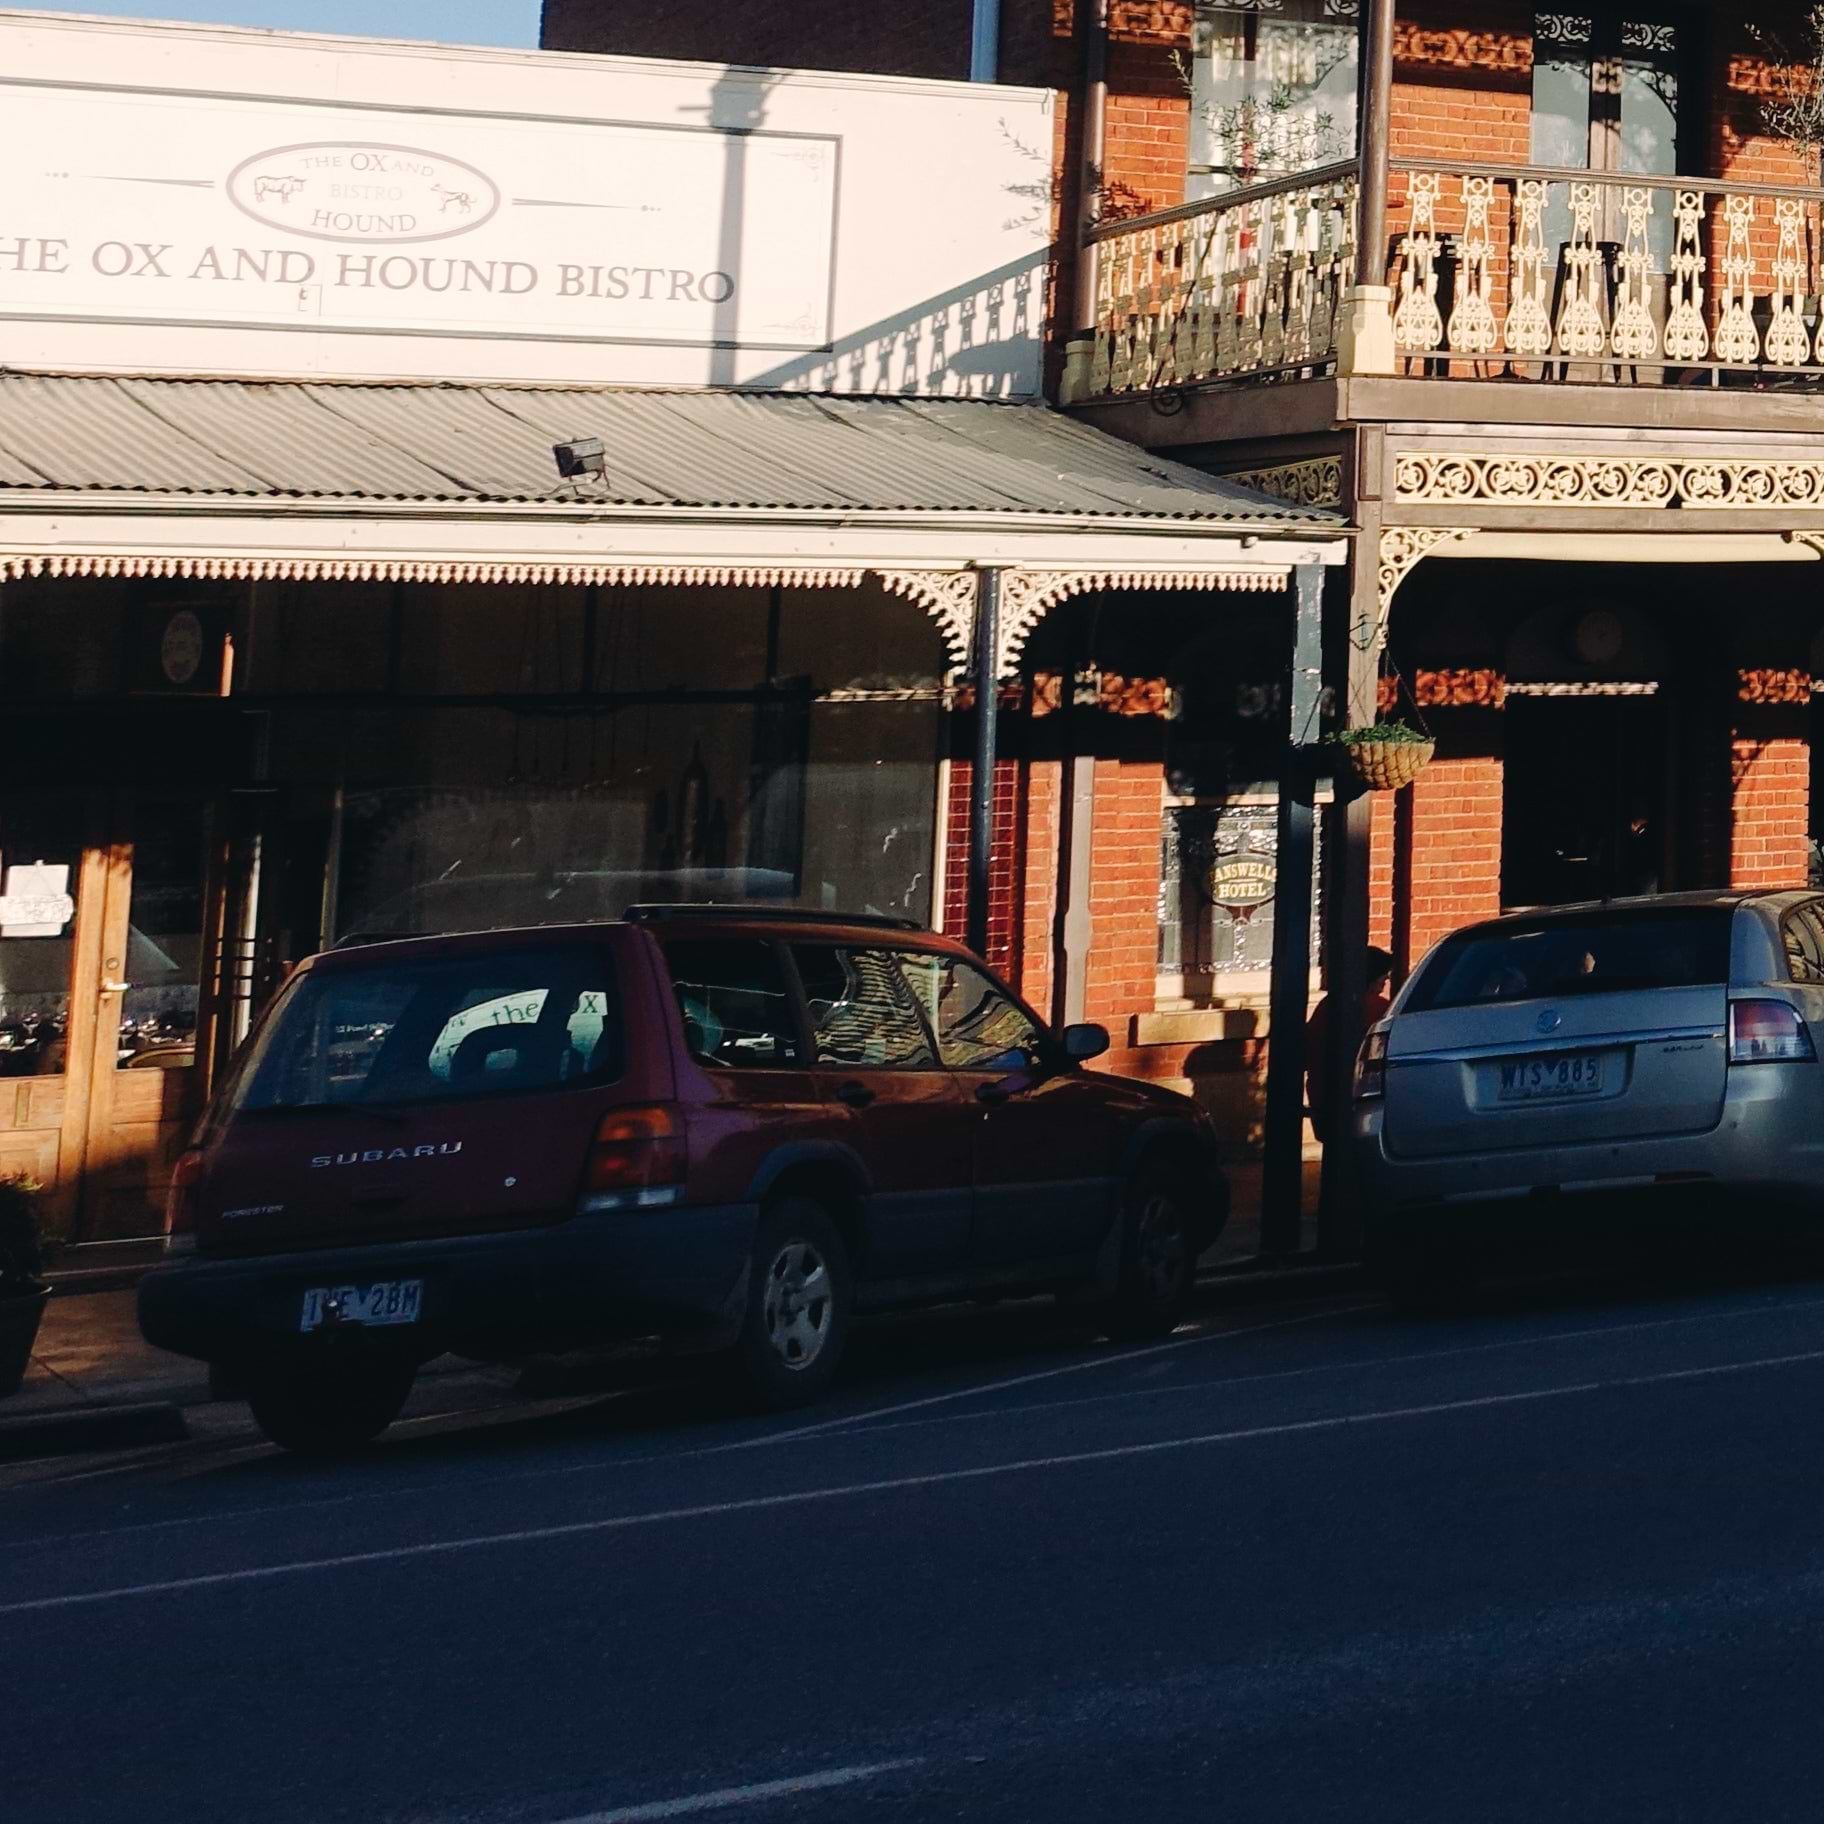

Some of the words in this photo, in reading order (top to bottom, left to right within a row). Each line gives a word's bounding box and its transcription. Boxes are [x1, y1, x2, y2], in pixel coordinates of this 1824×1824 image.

[299, 155, 343, 169] THE
[350, 152, 389, 172] OX
[391, 160, 435, 177] AND
[329, 183, 403, 201] BISTRO
[311, 209, 417, 233] HOUND
[0, 236, 70, 275] HE
[92, 240, 174, 278] OX
[190, 245, 316, 285] AND
[333, 253, 538, 295] HOUND
[556, 263, 735, 304] BISTRO
[1214, 862, 1277, 883] ANSWELLS
[1218, 882, 1267, 899] HOTEL
[1500, 1062, 1542, 1088] WTS
[1557, 1058, 1597, 1084] 885
[310, 1141, 463, 1168] SUBARU
